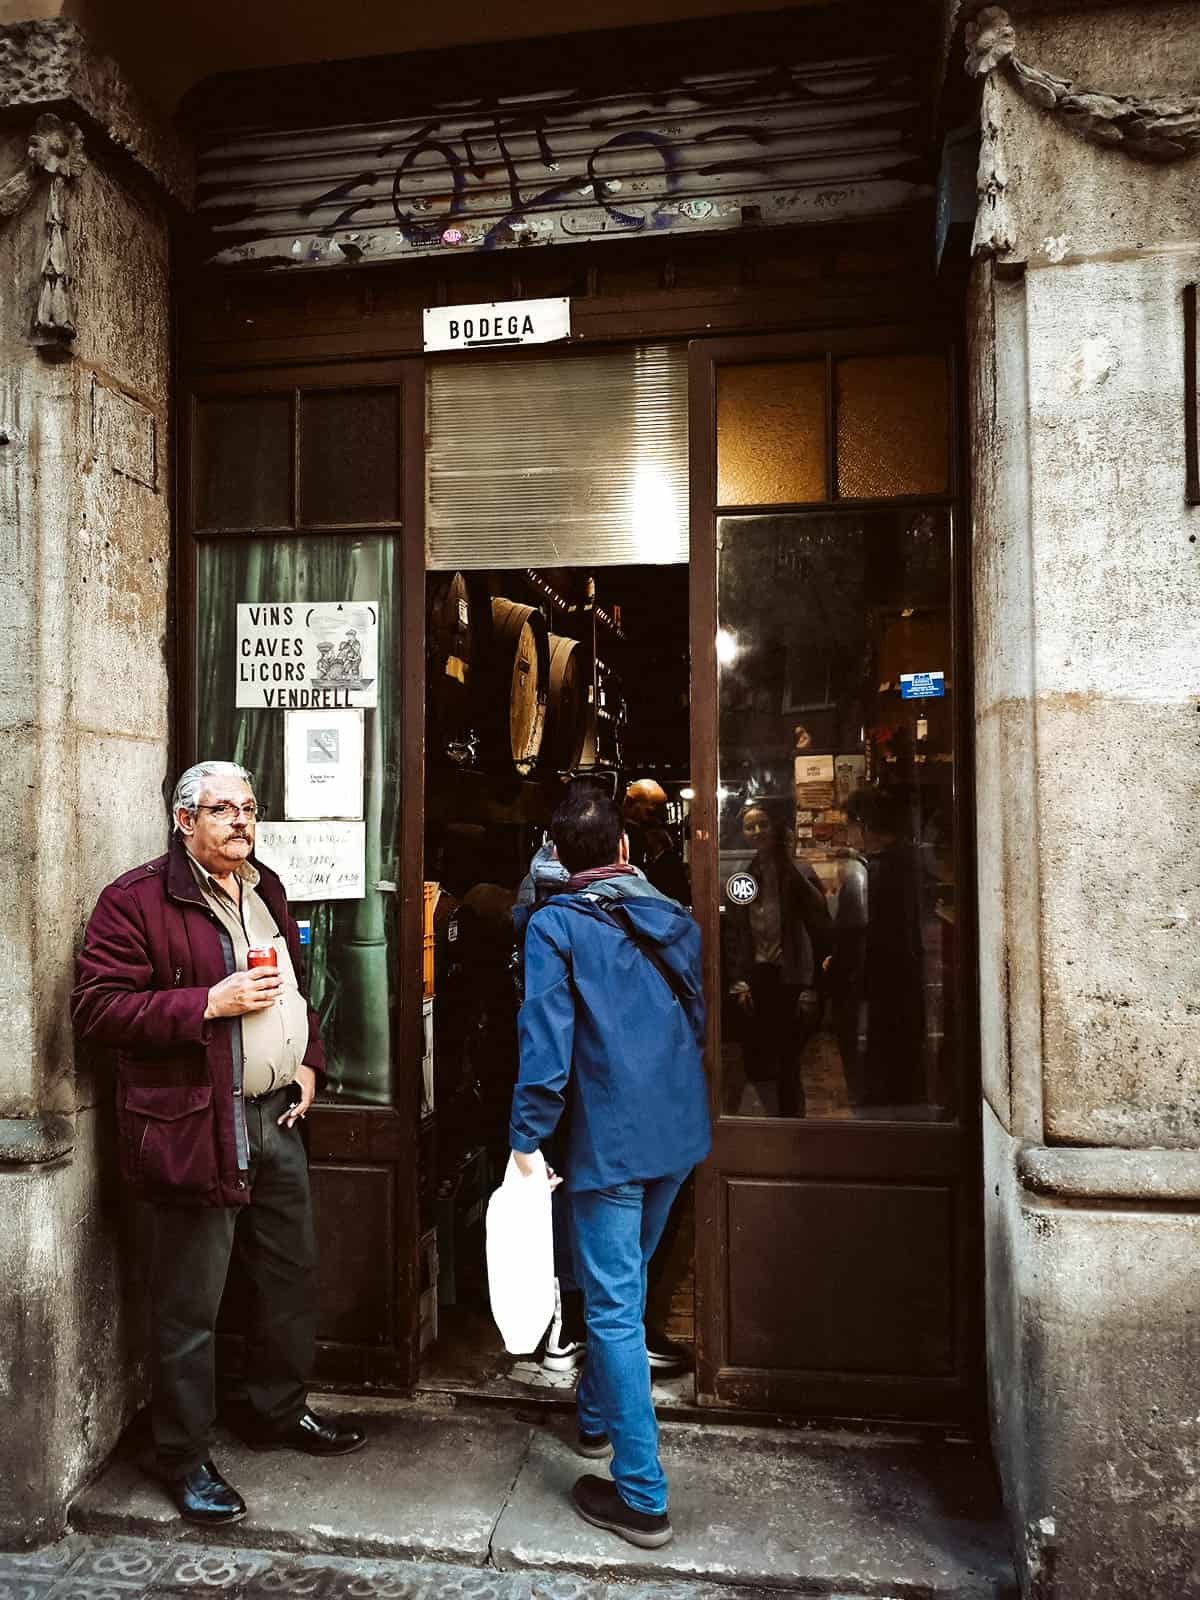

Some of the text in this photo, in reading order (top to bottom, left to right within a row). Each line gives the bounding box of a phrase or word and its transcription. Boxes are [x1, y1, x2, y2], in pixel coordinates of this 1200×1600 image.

[449, 314, 535, 340] BODEGA
[241, 638, 303, 657] CAVES
[263, 688, 353, 707] VENDRELL
[733, 879, 753, 898] DAS
